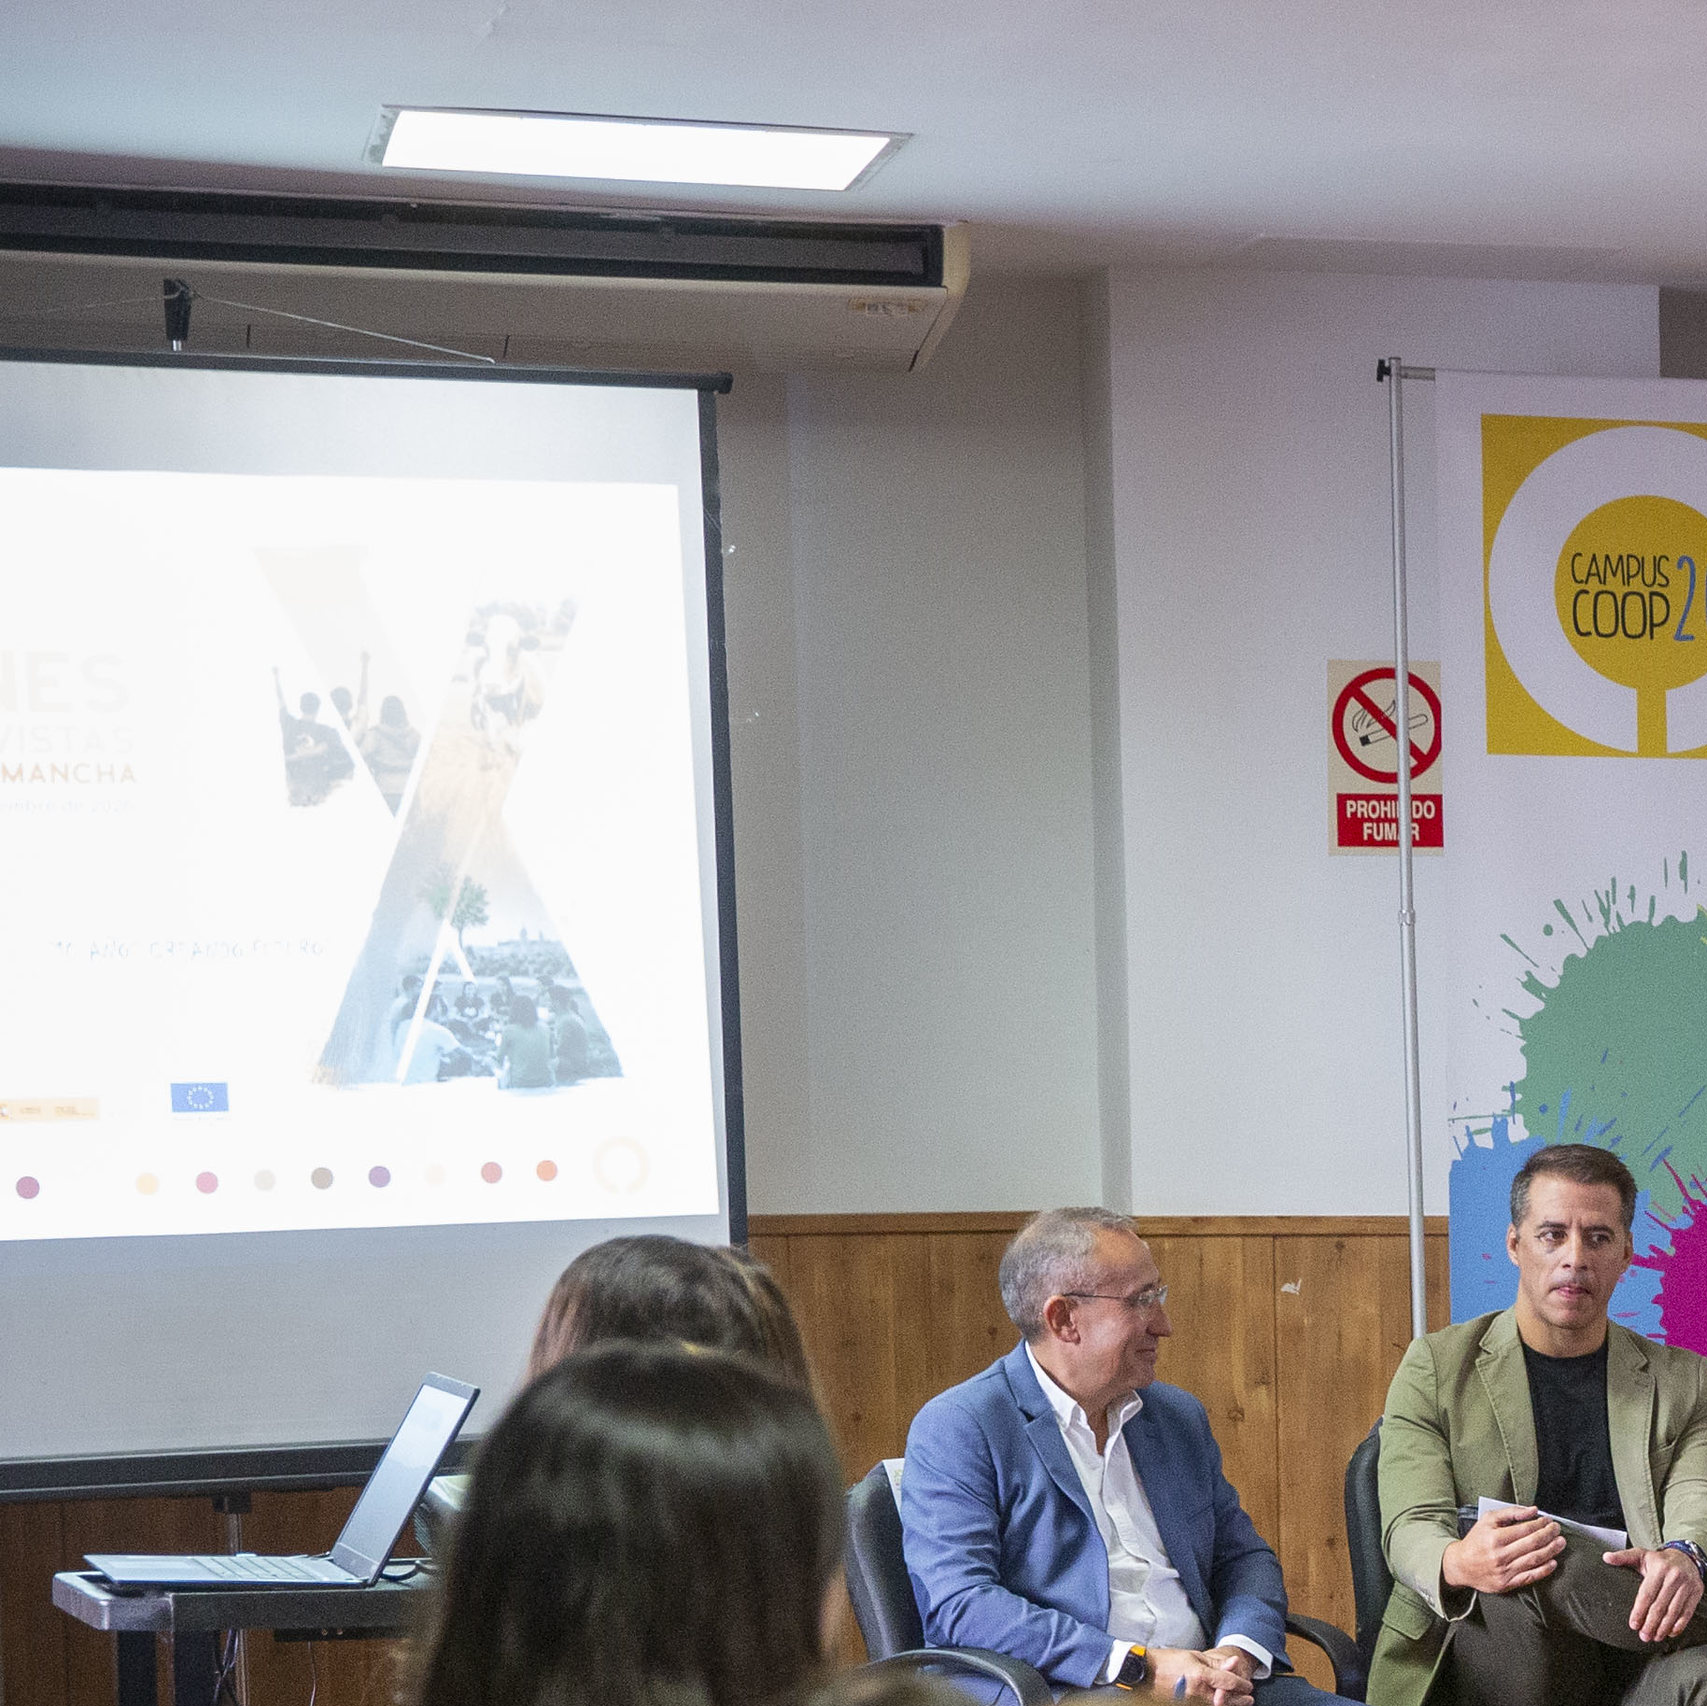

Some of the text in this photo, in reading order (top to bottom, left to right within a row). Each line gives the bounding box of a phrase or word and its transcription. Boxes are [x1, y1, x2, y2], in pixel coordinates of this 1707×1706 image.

[1571, 553, 1670, 587] CAMPUS
[1572, 589, 1671, 640] COOP
[1346, 799, 1435, 819] PROHIDO
[1363, 822, 1420, 841] FUMR
